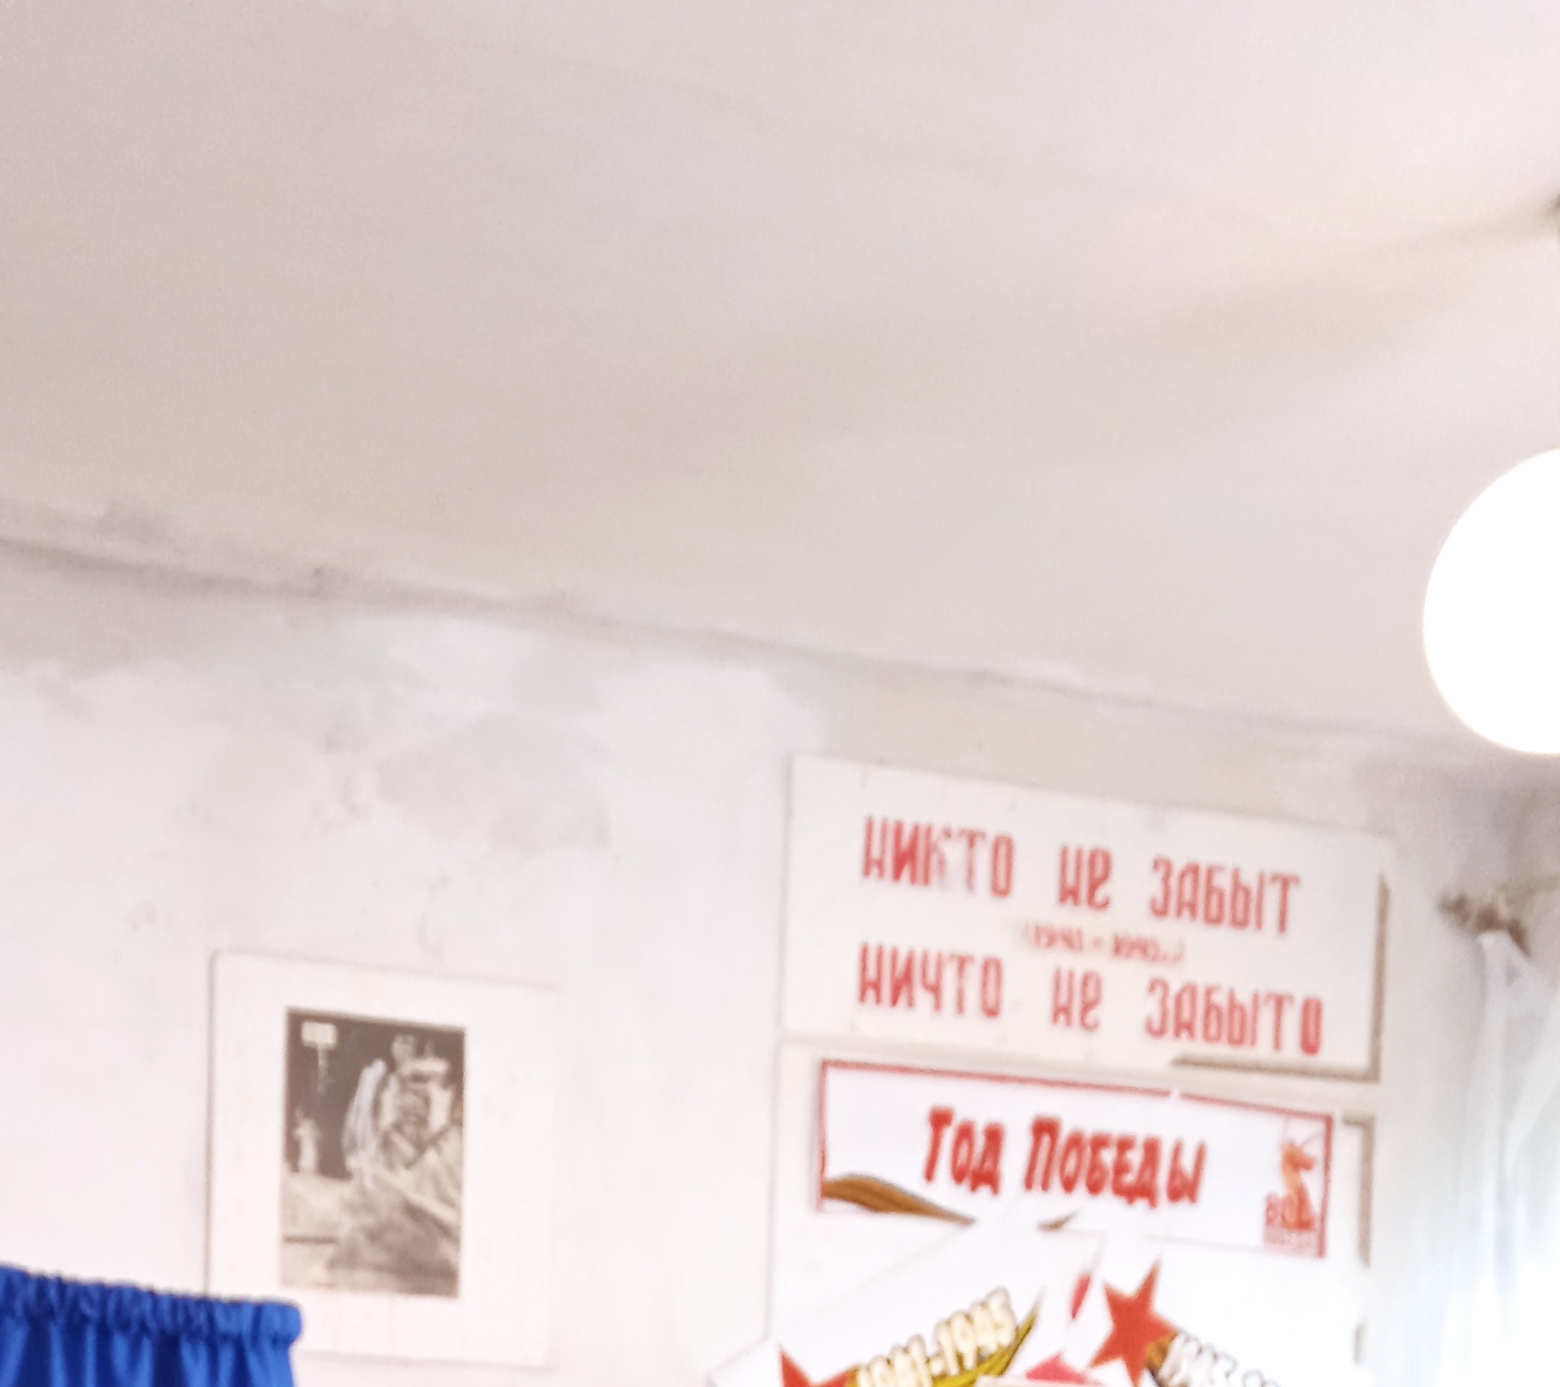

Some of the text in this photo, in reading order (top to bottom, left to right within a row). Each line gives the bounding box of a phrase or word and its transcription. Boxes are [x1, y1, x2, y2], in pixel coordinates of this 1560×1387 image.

[861, 815, 1016, 900] НИКТО
[1149, 855, 1301, 935] ЗАБЫТ
[856, 942, 1003, 1019] НИЧТО
[1145, 978, 1323, 1056] ЗАБЫТО
